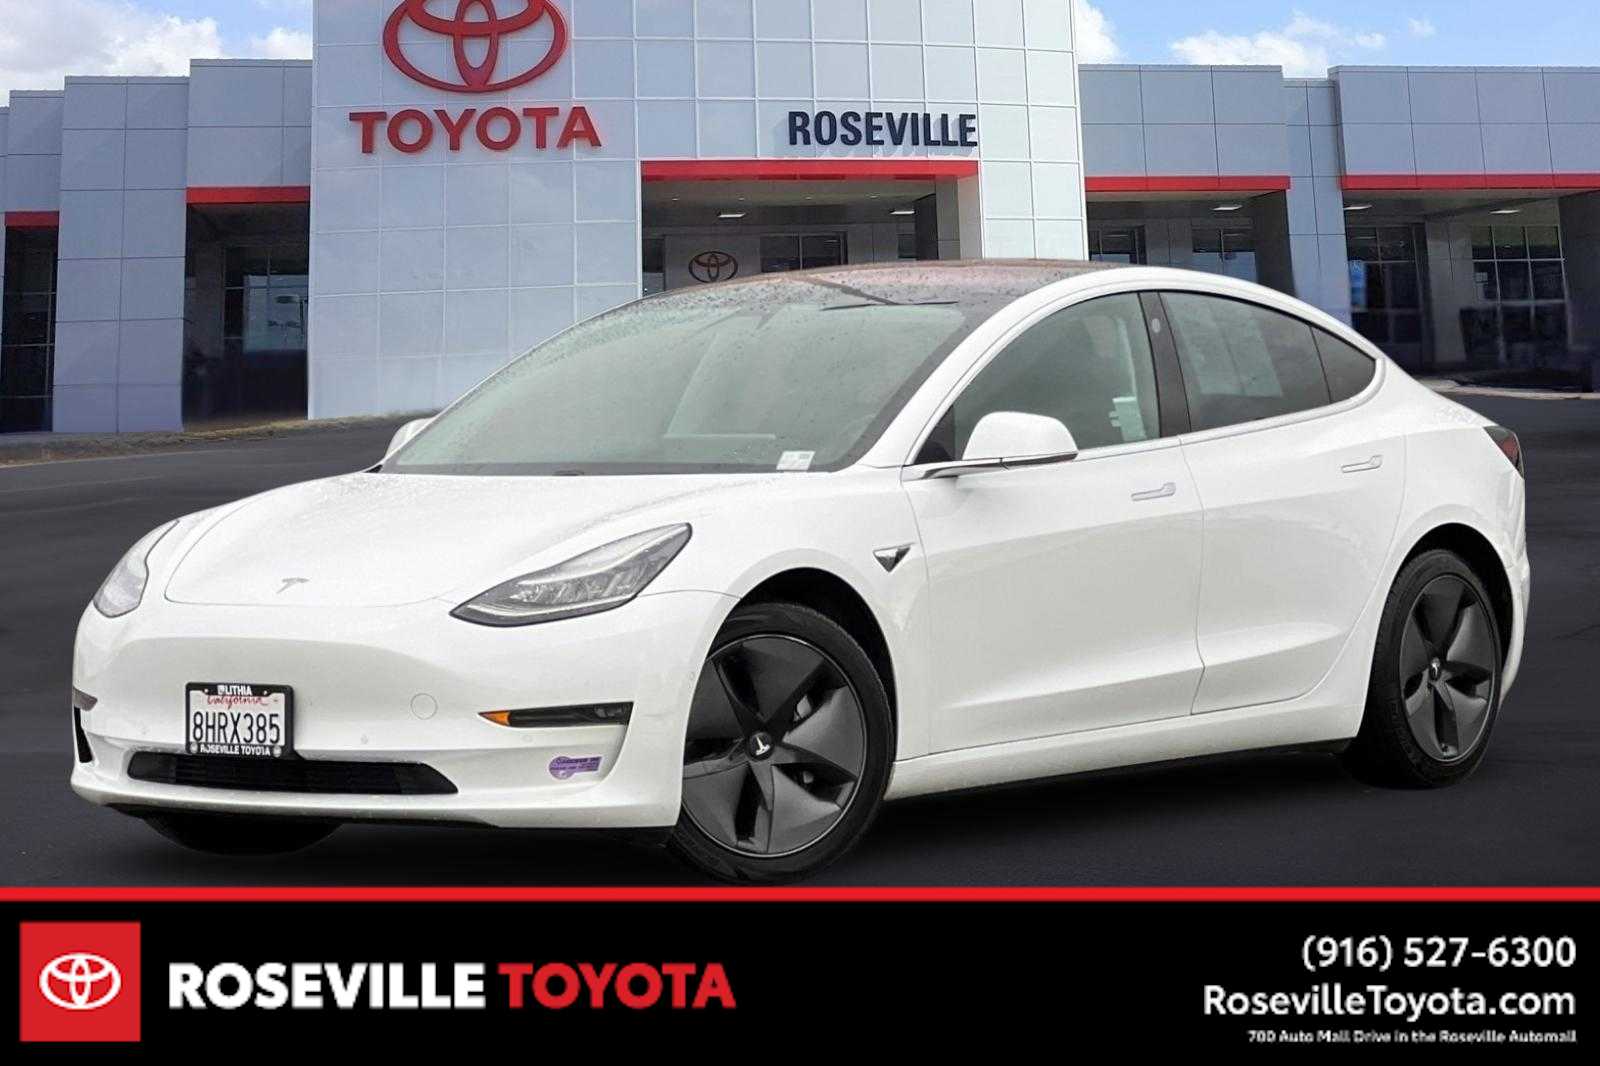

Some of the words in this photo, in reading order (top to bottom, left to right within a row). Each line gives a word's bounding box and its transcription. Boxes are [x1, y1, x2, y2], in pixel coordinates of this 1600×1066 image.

[349, 106, 603, 154] TOYOTA
[789, 111, 978, 147] ROSEVILLE
[206, 695, 270, 709] California
[225, 685, 252, 696] LITHIA
[192, 711, 280, 744] 8HRX385
